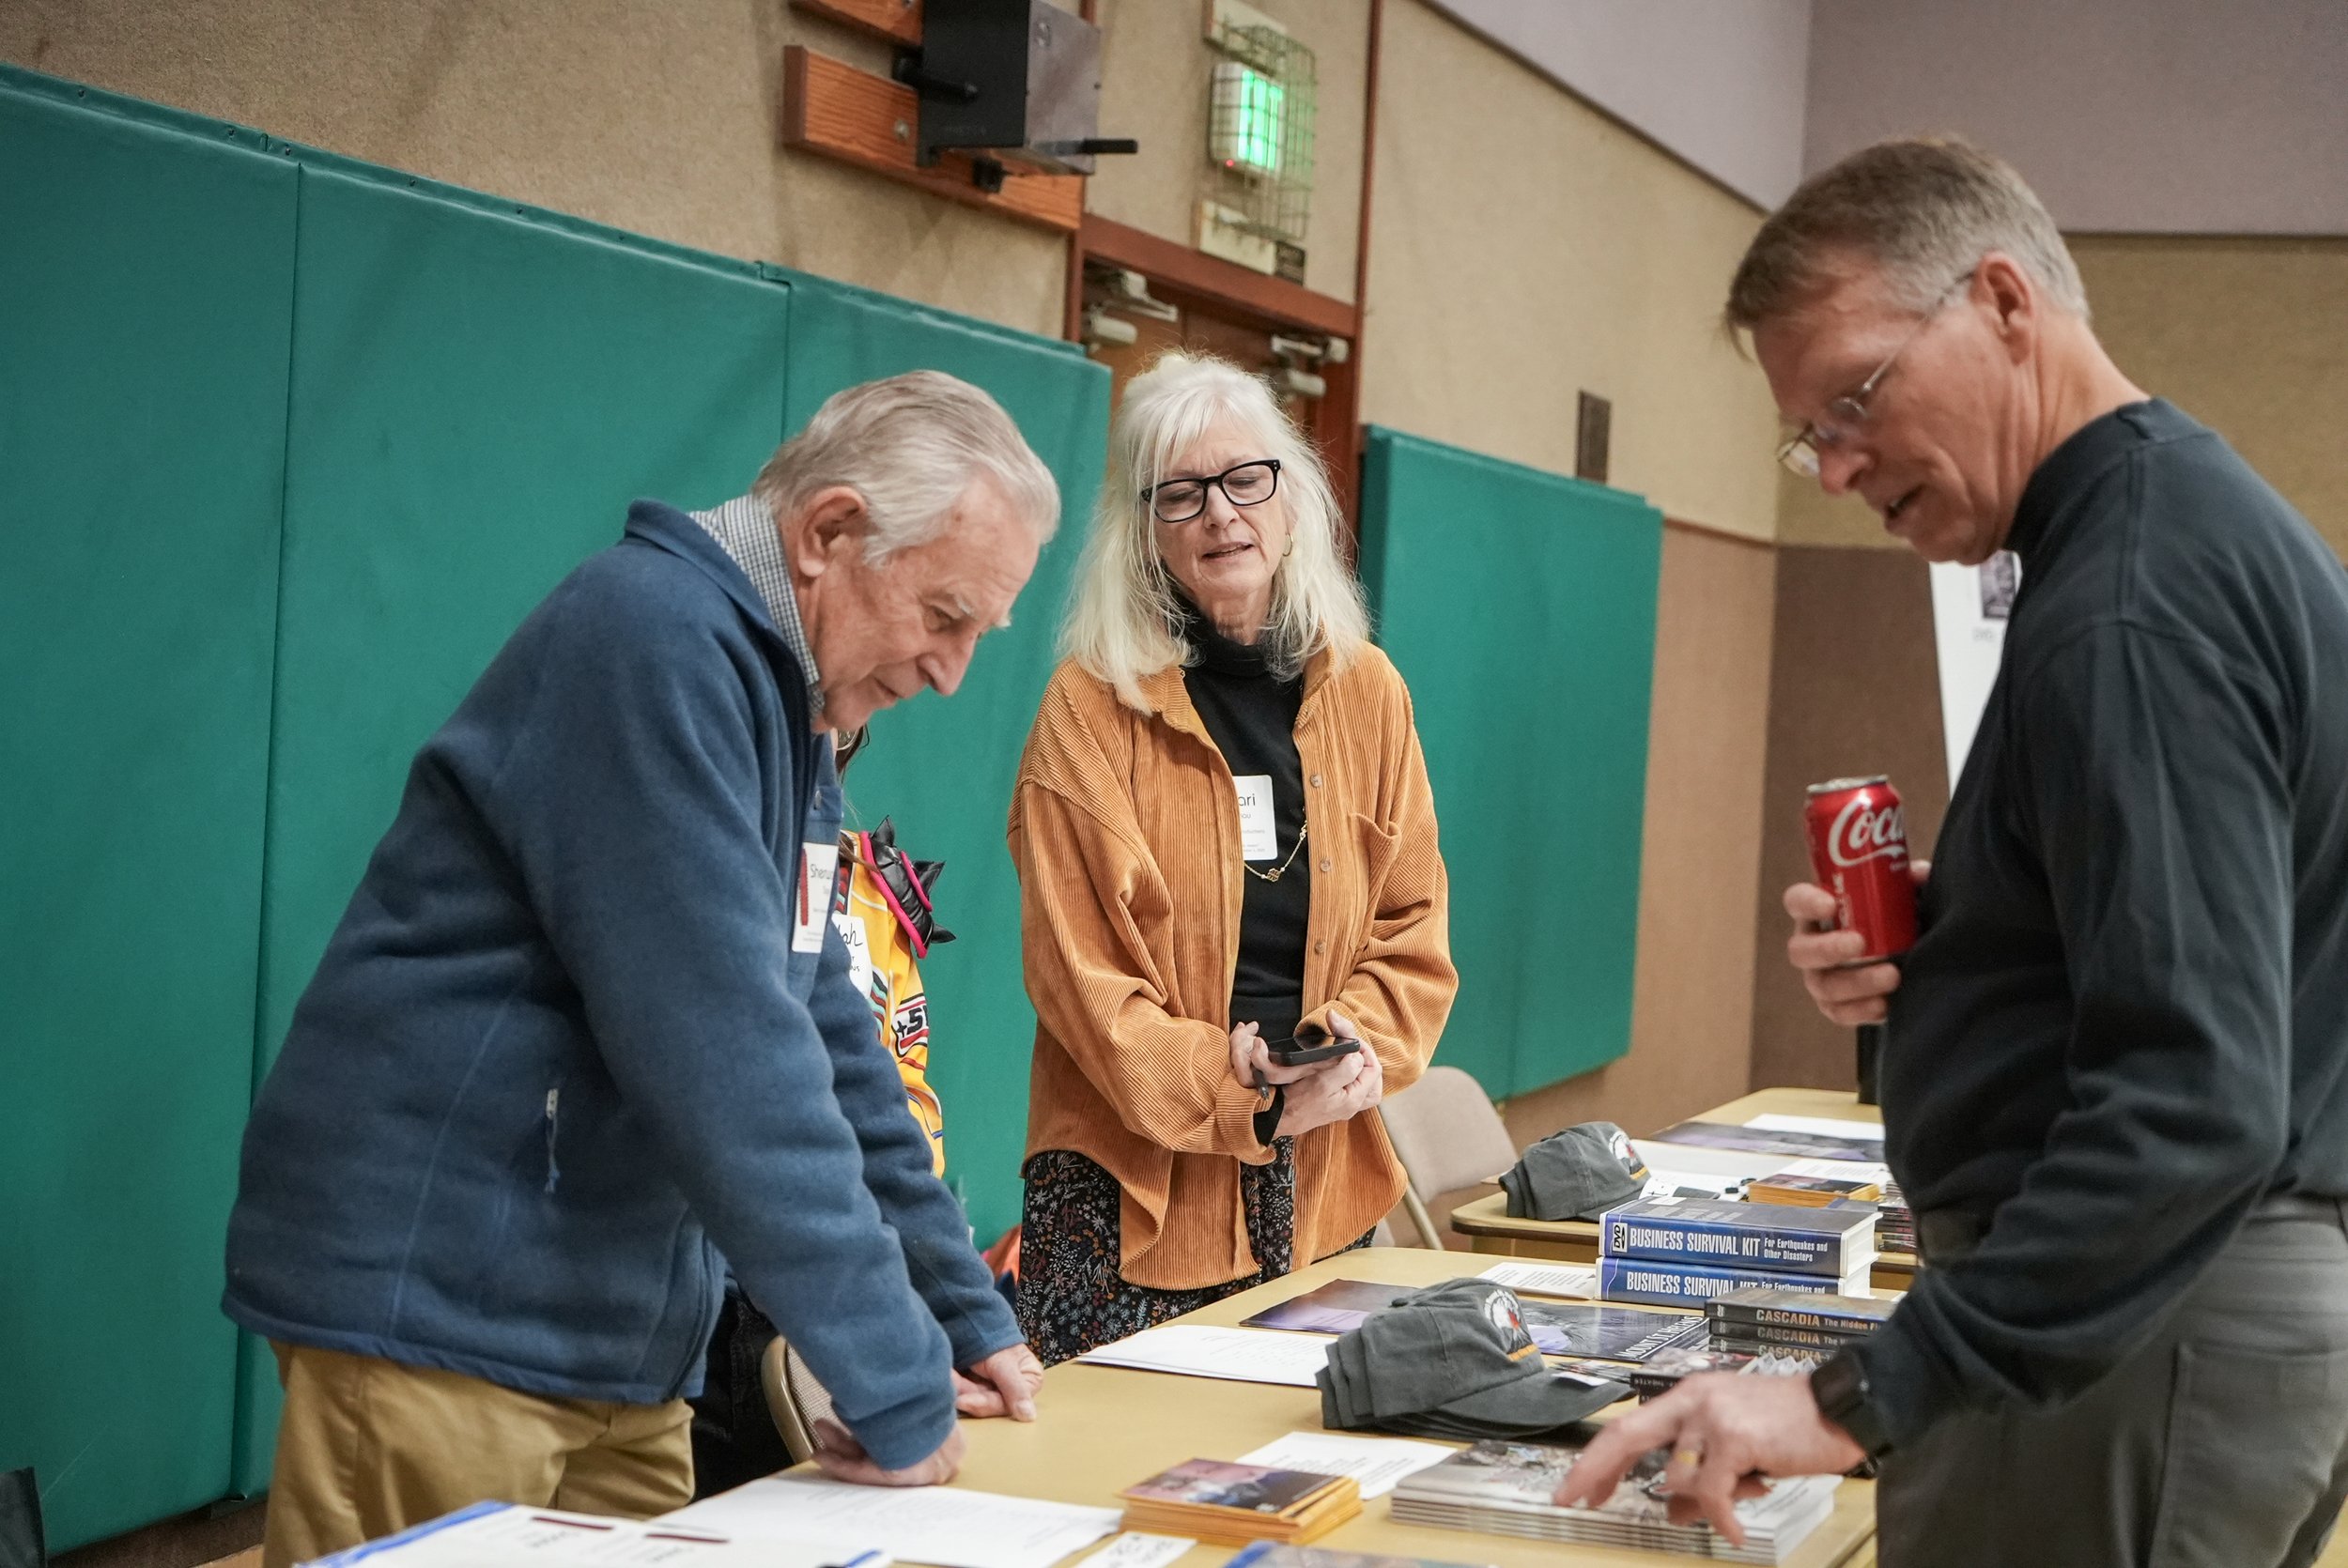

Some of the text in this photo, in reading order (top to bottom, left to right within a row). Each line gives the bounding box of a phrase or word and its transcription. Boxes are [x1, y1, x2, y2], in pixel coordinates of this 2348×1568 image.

[1238, 792, 1256, 807] ari
[1630, 1227, 1828, 1257] BUSINESS SURVIVAL KIT For Earthquakes and
[1764, 1248, 1814, 1262] Other Disasters
[1626, 1271, 1680, 1294] BUSINESS
[1756, 1309, 1820, 1328] CASCADIA
[1824, 1317, 1839, 1328] The
[1841, 1319, 1869, 1330] Hidden
[1757, 1327, 1820, 1345] CASCADIA
